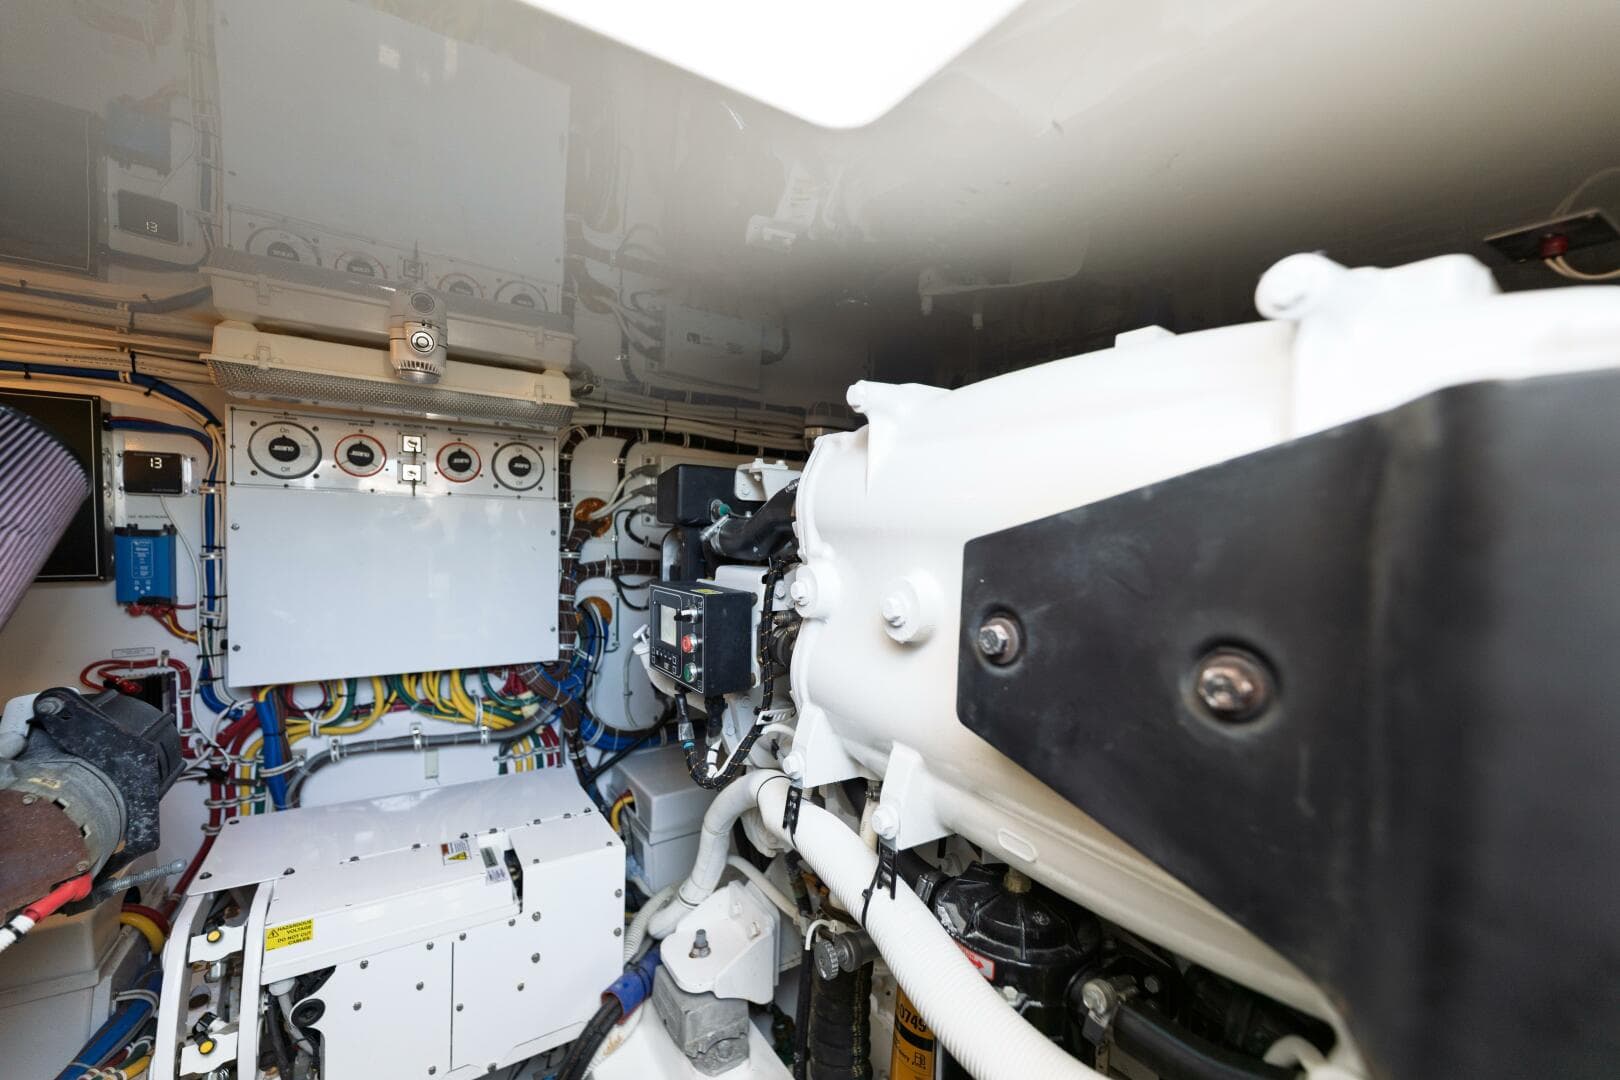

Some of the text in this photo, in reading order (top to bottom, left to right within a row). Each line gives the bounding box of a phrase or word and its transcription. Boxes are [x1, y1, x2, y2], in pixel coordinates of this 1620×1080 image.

[150, 457, 162, 469] 13
[278, 919, 312, 931] HAZARDOUS
[286, 925, 312, 935] VOLTAGE
